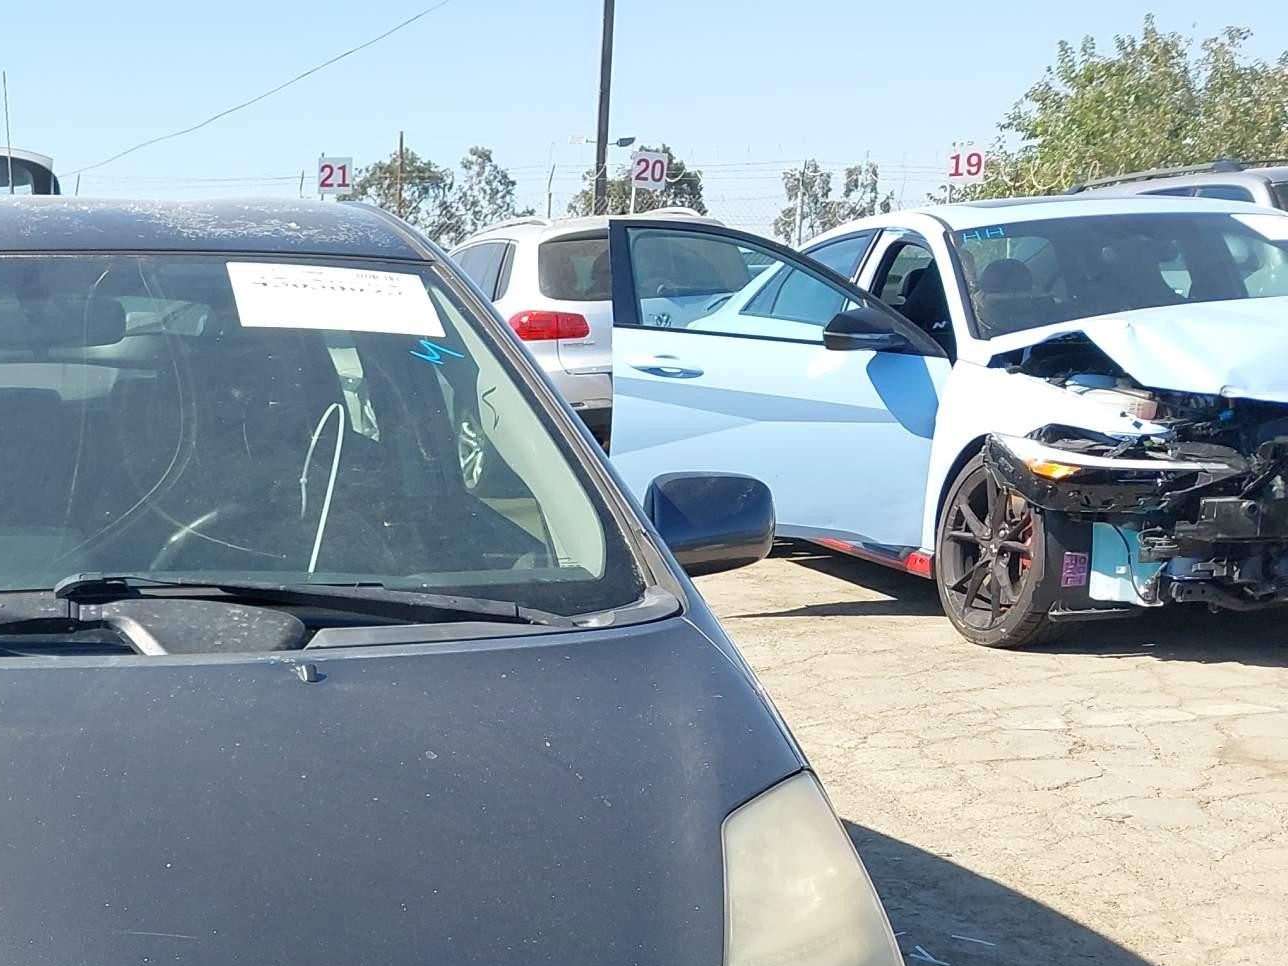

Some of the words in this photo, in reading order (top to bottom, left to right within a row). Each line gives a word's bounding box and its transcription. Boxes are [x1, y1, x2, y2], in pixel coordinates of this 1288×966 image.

[319, 164, 350, 188] 21
[635, 158, 665, 183] 20
[948, 152, 982, 177] 19
